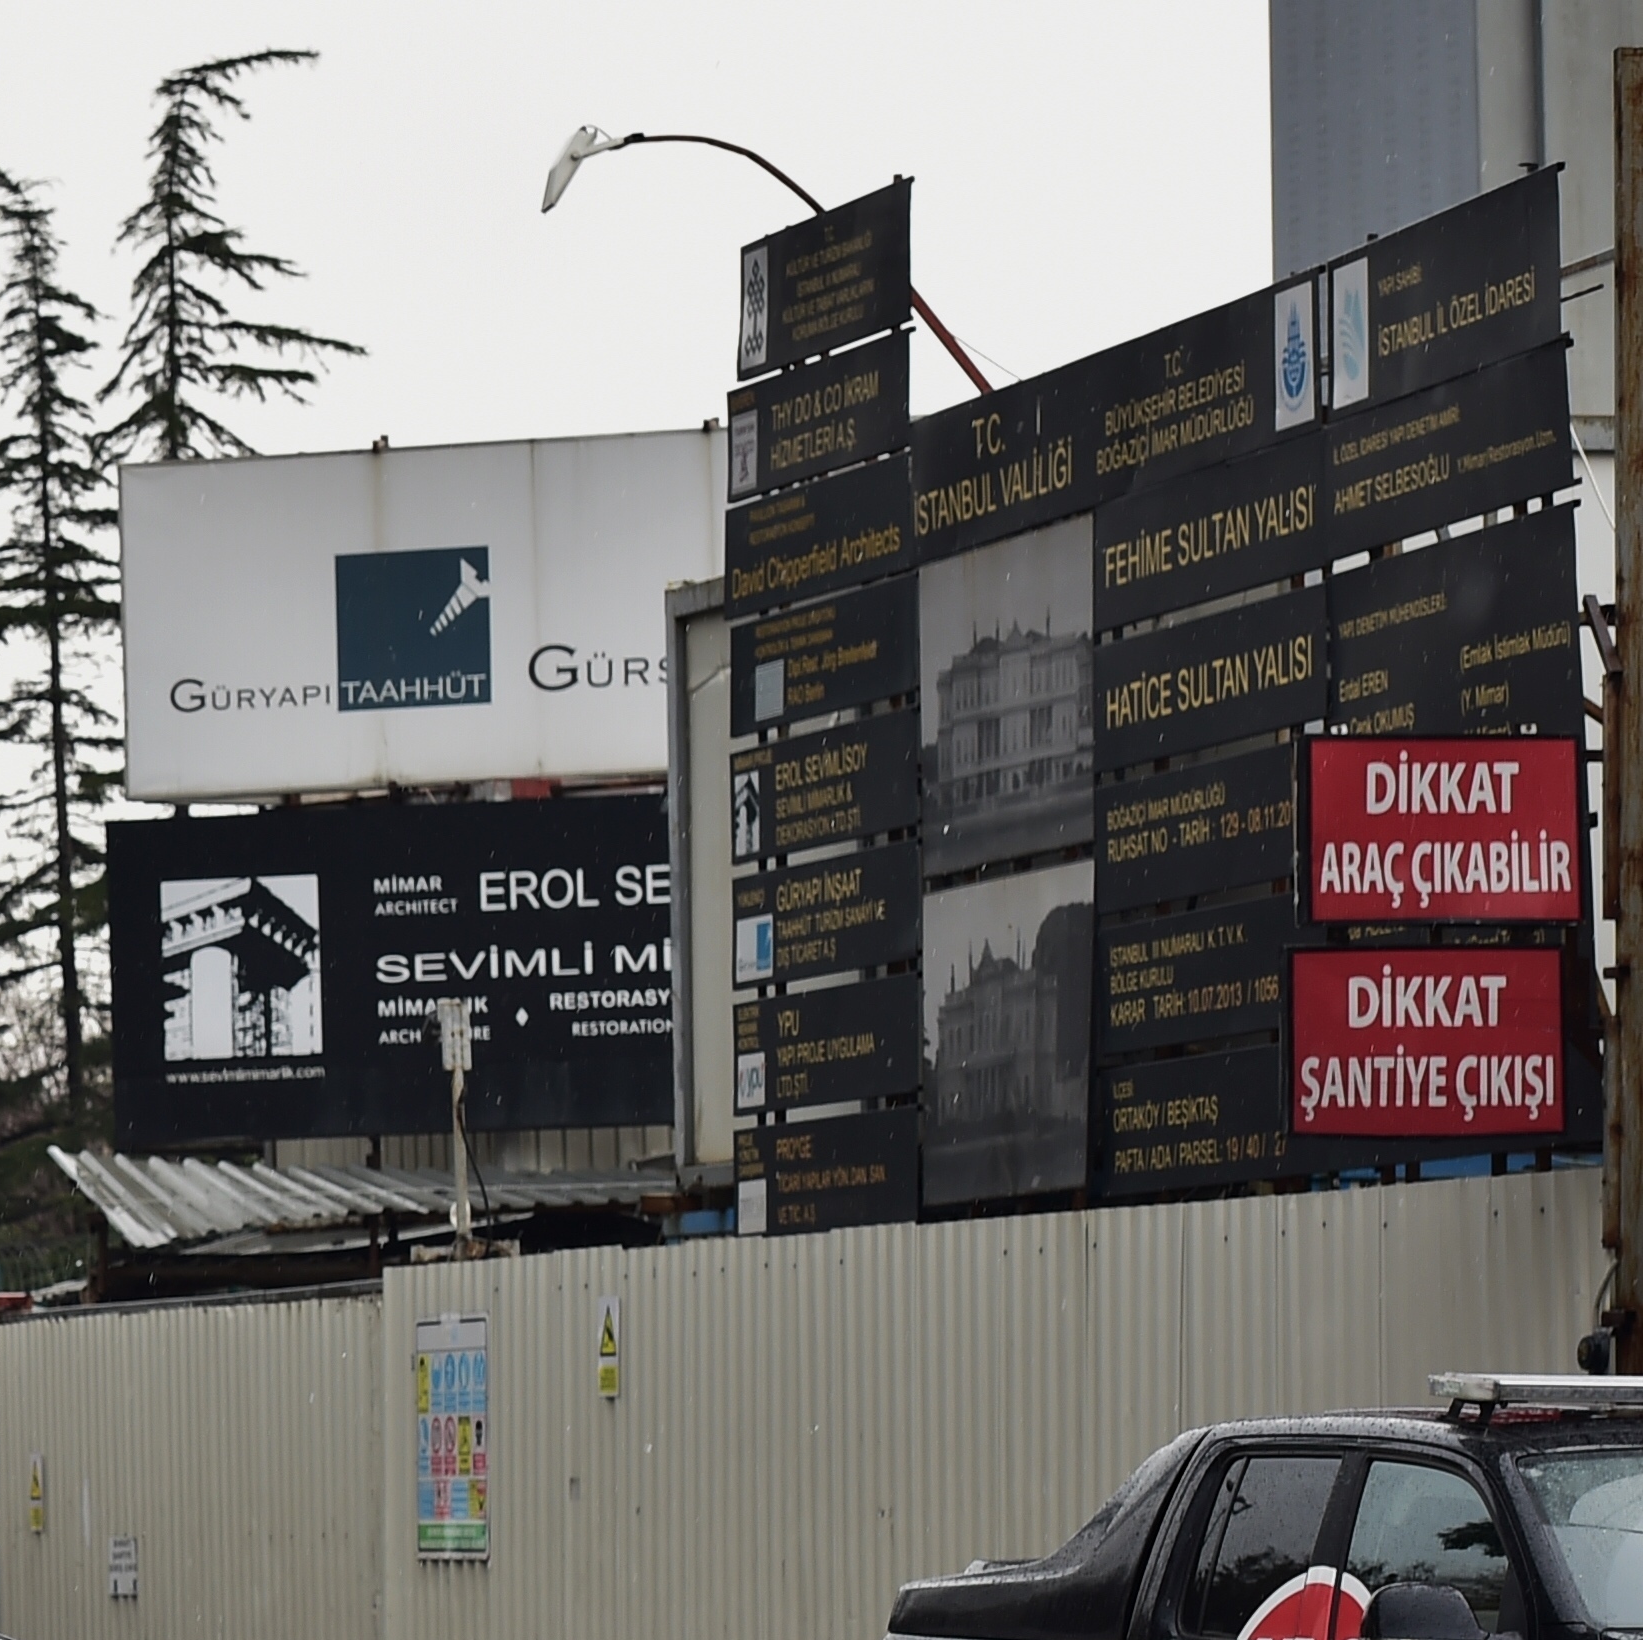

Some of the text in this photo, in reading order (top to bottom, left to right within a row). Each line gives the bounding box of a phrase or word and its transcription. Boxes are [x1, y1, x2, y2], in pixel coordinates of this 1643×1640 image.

[1377, 274, 1395, 297] YAPI
[1378, 265, 1536, 358] İSTANBUL İL ÖZEL İDARESİ
[771, 371, 880, 431] THY DO & CO İKRAM
[1105, 359, 1245, 436] BÜYÜKŞEHİR BELEDİYESİ
[971, 412, 1006, 460] T.C.
[1096, 393, 1255, 475] BOĞAZİÇİ İMAR MÜDÜRLÜĞÜ
[914, 436, 1073, 538] İSTANBUL VALİLİĞİ
[1333, 476, 1373, 515] AHMET
[1104, 485, 1313, 589] FEHİME SULTAN YALISI
[731, 561, 765, 600] David
[767, 540, 837, 591] Chipperfield
[840, 522, 902, 569] Architects
[1460, 620, 1572, 674] (Emlak İstimlak Müdürü)
[170, 678, 331, 713] GÜRYAPI
[341, 670, 487, 704] TAAHHÜT
[1105, 634, 1313, 731] HATİCE SULTAN YALISI
[1339, 669, 1389, 703] Erdal EREN
[775, 760, 803, 792] EROL
[1366, 750, 1520, 815] DİKKAT
[1107, 801, 1147, 832] BOĞAZİÇİ
[1148, 797, 1170, 821] İMAR
[1108, 831, 1150, 864] RUHSAT
[1151, 828, 1168, 855] NO
[1220, 811, 1240, 839] 129
[373, 873, 443, 895] MİMAR
[479, 867, 600, 912] EROL
[776, 868, 863, 913] GÜRYAPI İNŞAAT
[1320, 830, 1572, 909] ARAÇ ÇIKABİLİR
[374, 898, 459, 917] ARCHITECT
[777, 913, 812, 941] TAAHHÜT
[375, 940, 593, 984] SEVİMLİ
[1109, 942, 1149, 969] İSTANBUL
[1160, 931, 1205, 957] NUMARALI
[1109, 997, 1147, 1028] KARAR
[1253, 974, 1280, 1003] 1056
[1110, 965, 1175, 995] BÖLGE KURULU
[1347, 964, 1507, 1029] DİKKAT
[777, 1009, 800, 1038] YPU
[776, 1042, 797, 1068] YAPI
[797, 1038, 825, 1065] PROJE
[827, 1032, 876, 1061] UYGULAMA
[1301, 1044, 1554, 1122] ŞANTİYE ÇIKIŞI
[1113, 1094, 1219, 1133] ORTAKÖY BEŞİKTAŞ
[1226, 1135, 1240, 1161] 19
[1245, 1133, 1260, 1160] 40
